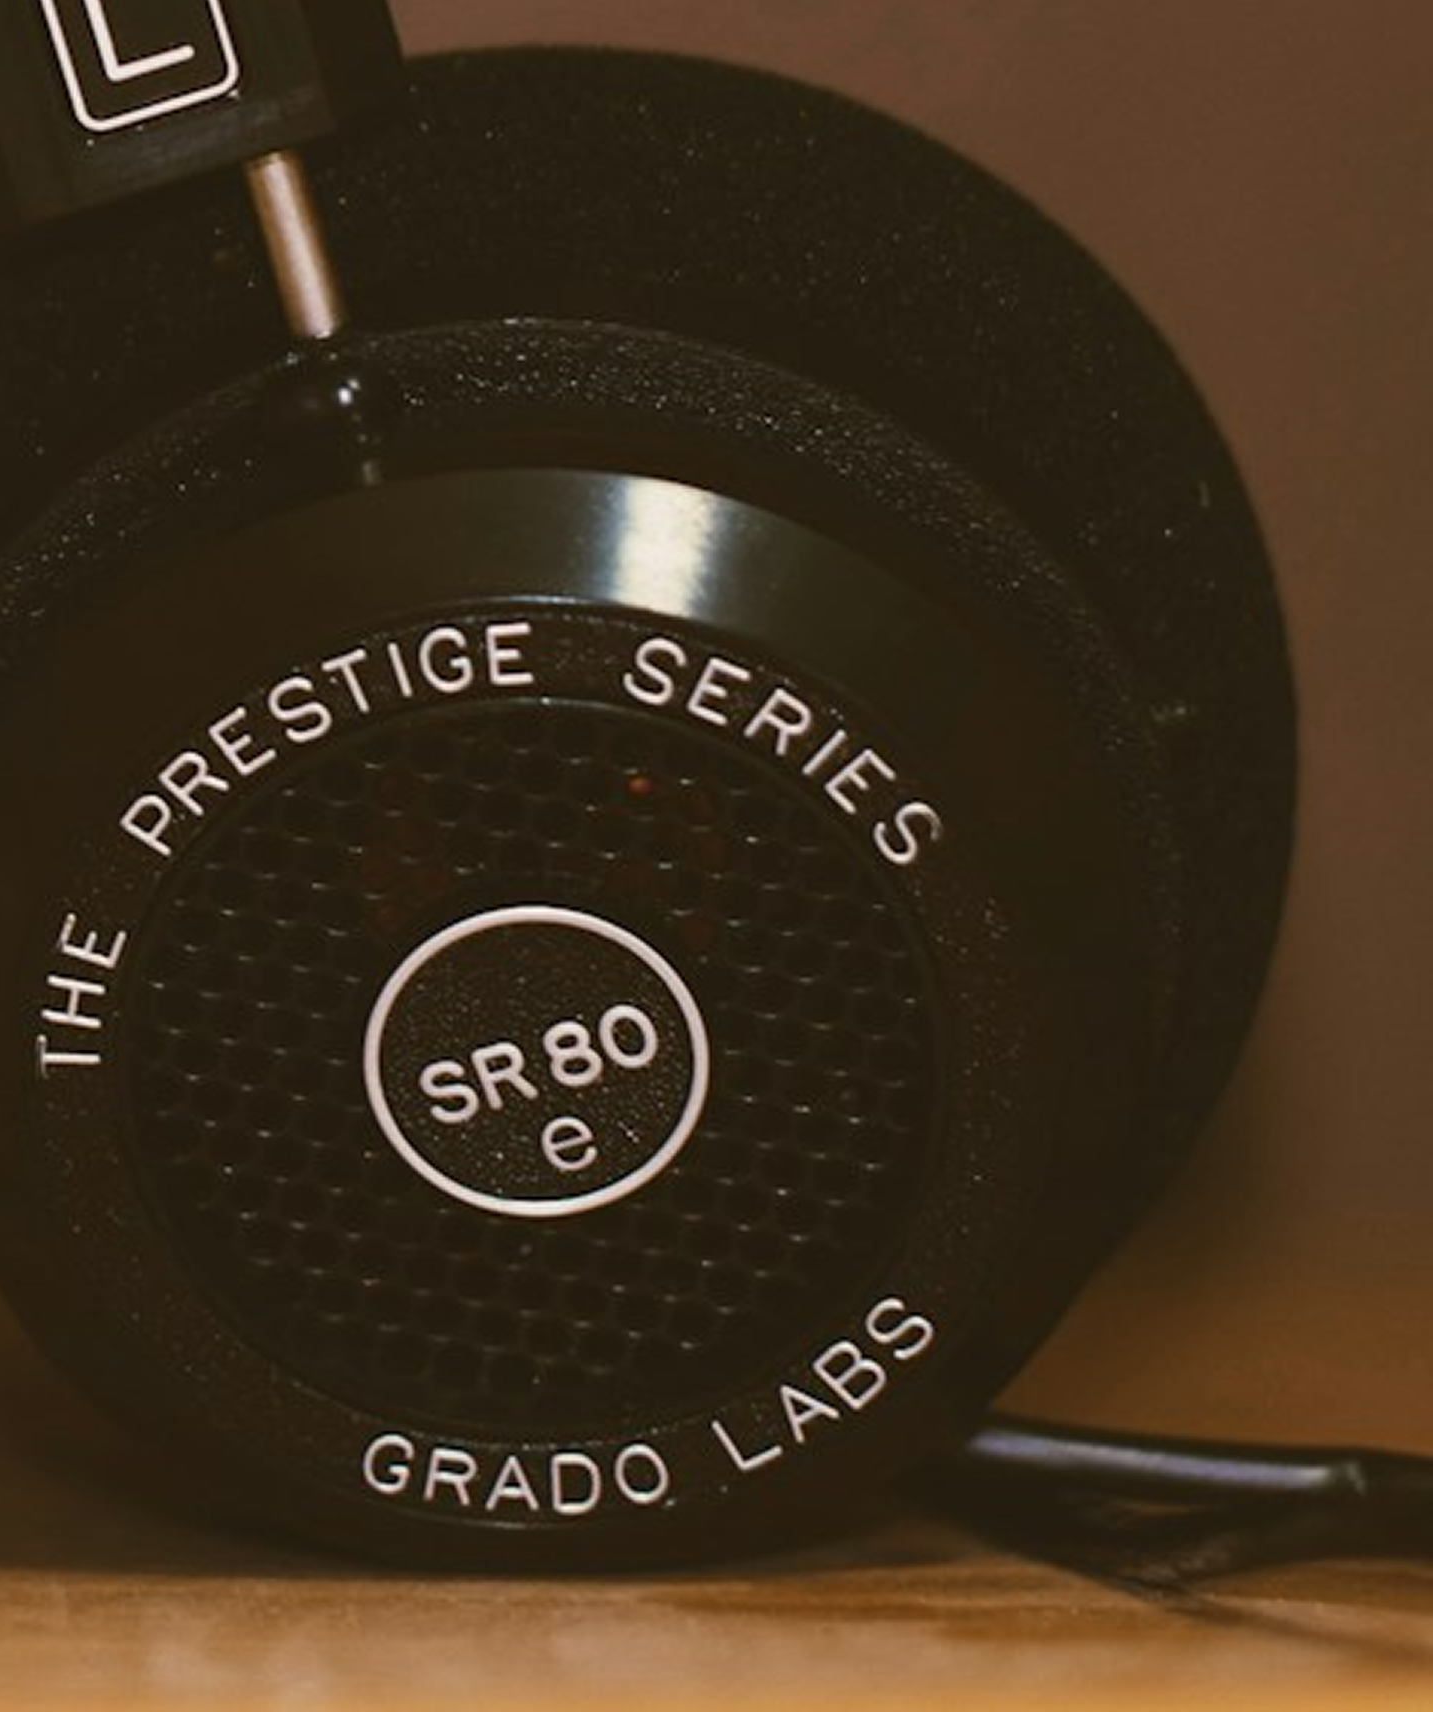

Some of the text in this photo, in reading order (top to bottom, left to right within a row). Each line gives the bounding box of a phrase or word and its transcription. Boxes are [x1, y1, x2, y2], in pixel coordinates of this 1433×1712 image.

[36, 621, 942, 1079] THE PRESTIGE SERIES
[540, 1114, 597, 1172] e
[362, 1296, 935, 1515] GRADO LABS
